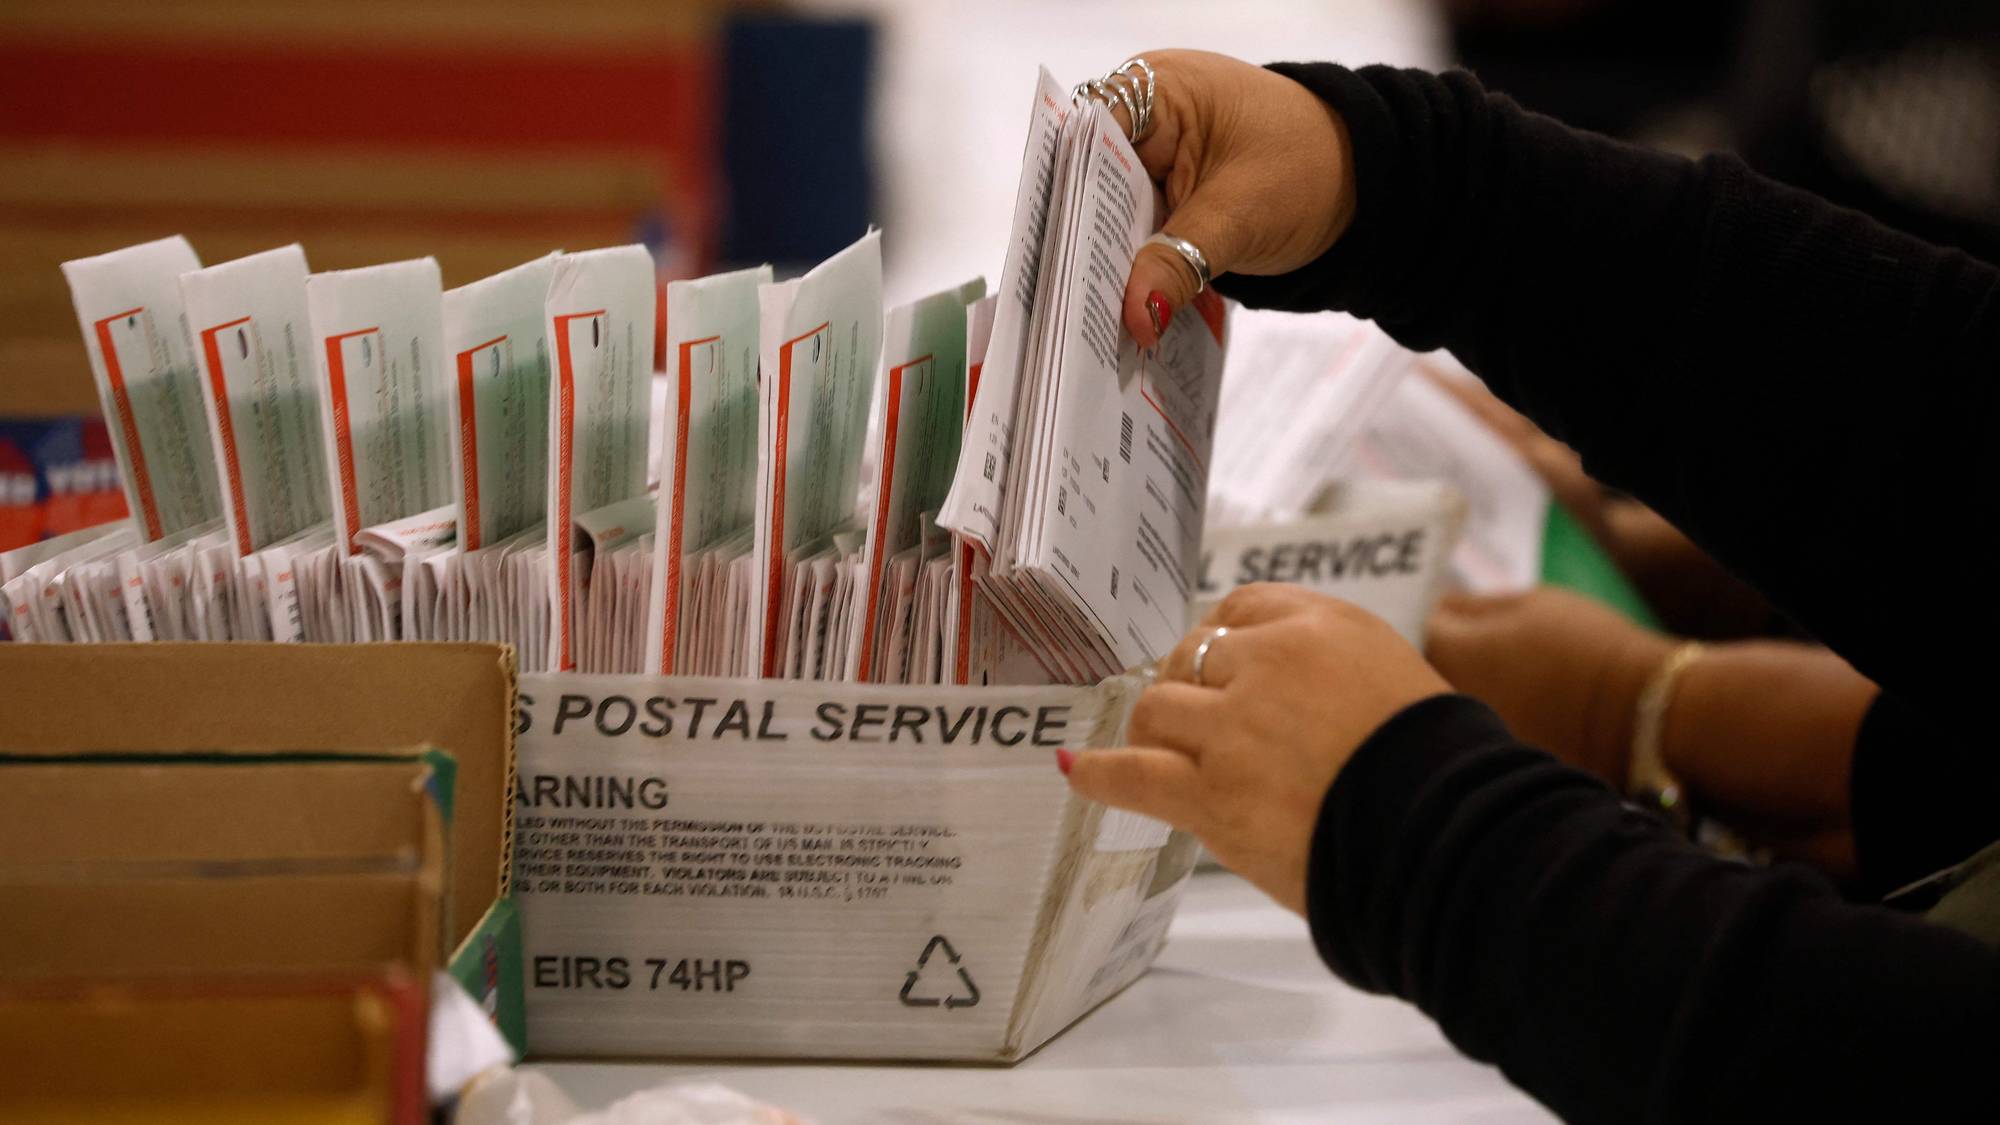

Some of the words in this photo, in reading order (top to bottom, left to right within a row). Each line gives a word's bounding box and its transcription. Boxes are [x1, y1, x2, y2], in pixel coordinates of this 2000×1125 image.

[1234, 529, 1425, 586] SERVICE
[552, 693, 789, 741] POSTAL
[809, 701, 1072, 747] SERVICE
[548, 818, 615, 831] WITHOUT
[619, 819, 649, 831] THE
[652, 819, 743, 833] PERMISSION
[747, 822, 764, 833] OF
[529, 832, 580, 846] OTHER
[584, 833, 624, 847] THAN
[628, 834, 657, 848] THE
[662, 835, 749, 850] TRANSPORT
[752, 837, 773, 851] OF
[776, 838, 799, 851] US
[567, 849, 645, 863] RESERVES
[649, 850, 676, 863] THE
[681, 852, 726, 865] RIGHT
[730, 852, 750, 866] TO
[754, 854, 783, 866] USE
[787, 853, 881, 868] ELECTRONIC
[885, 855, 962, 869] TRACKING
[519, 863, 562, 877] THEIR
[566, 864, 656, 880] EQUIPMENT.
[662, 867, 746, 882] VIOLATORS
[750, 868, 781, 882] ARE
[784, 869, 850, 884] SUBJECT
[857, 871, 877, 885] TO
[538, 880, 561, 893] OR
[564, 880, 606, 894] BOTH
[609, 880, 640, 895] FOR
[643, 881, 684, 896] EACH
[687, 882, 770, 898] VIOLATION.
[532, 955, 632, 990] EIRS
[645, 958, 751, 992] 74HP
